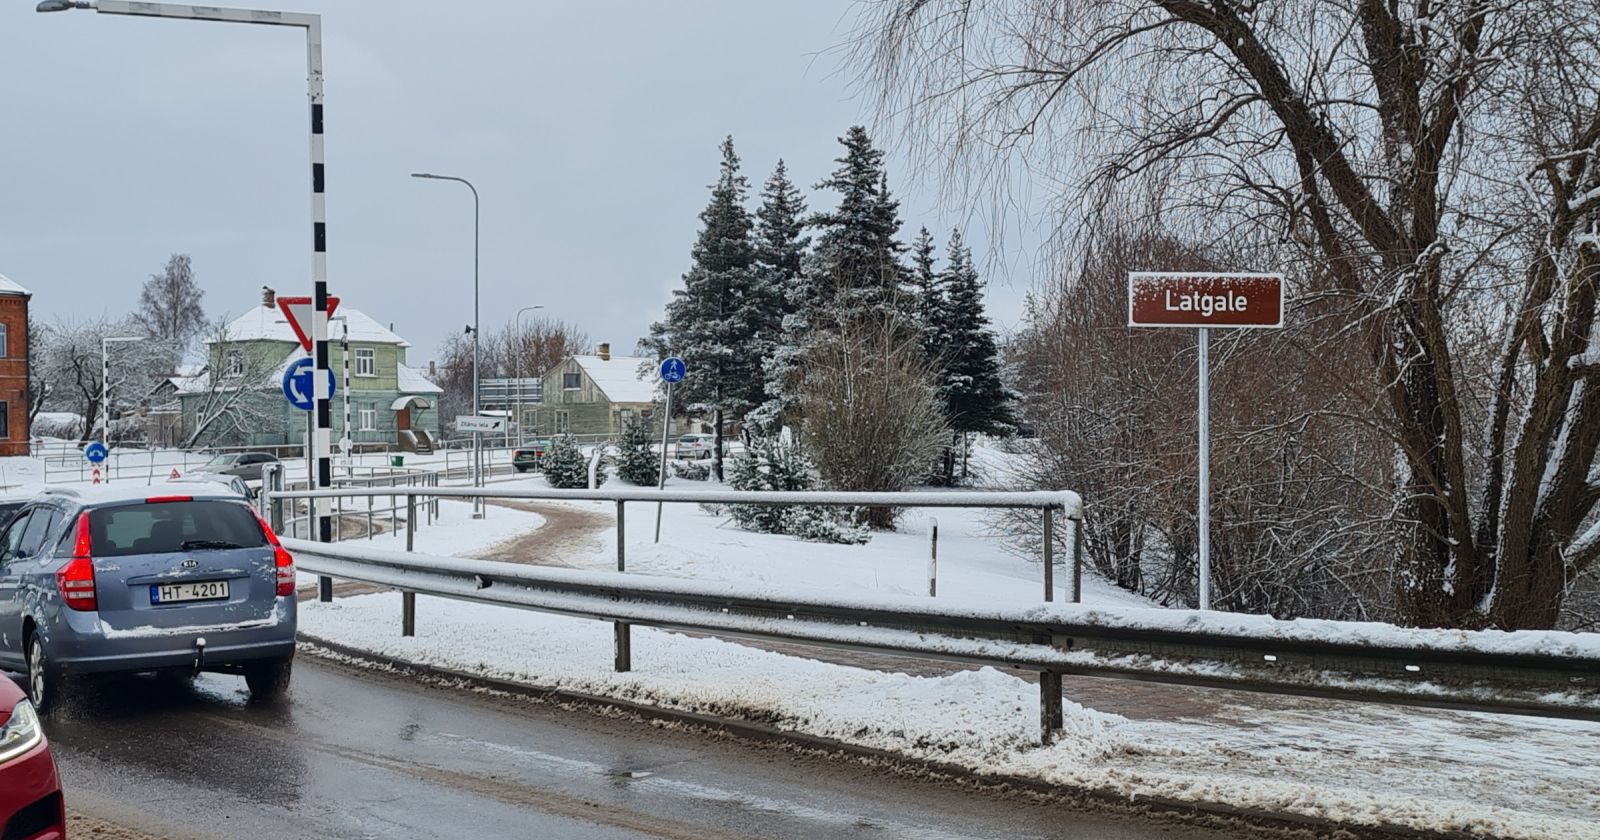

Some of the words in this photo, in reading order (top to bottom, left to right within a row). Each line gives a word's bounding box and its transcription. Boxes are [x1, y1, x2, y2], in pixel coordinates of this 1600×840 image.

[1165, 289, 1248, 317] Latgale
[183, 560, 197, 568] KIA
[161, 583, 225, 600] HT-4201
